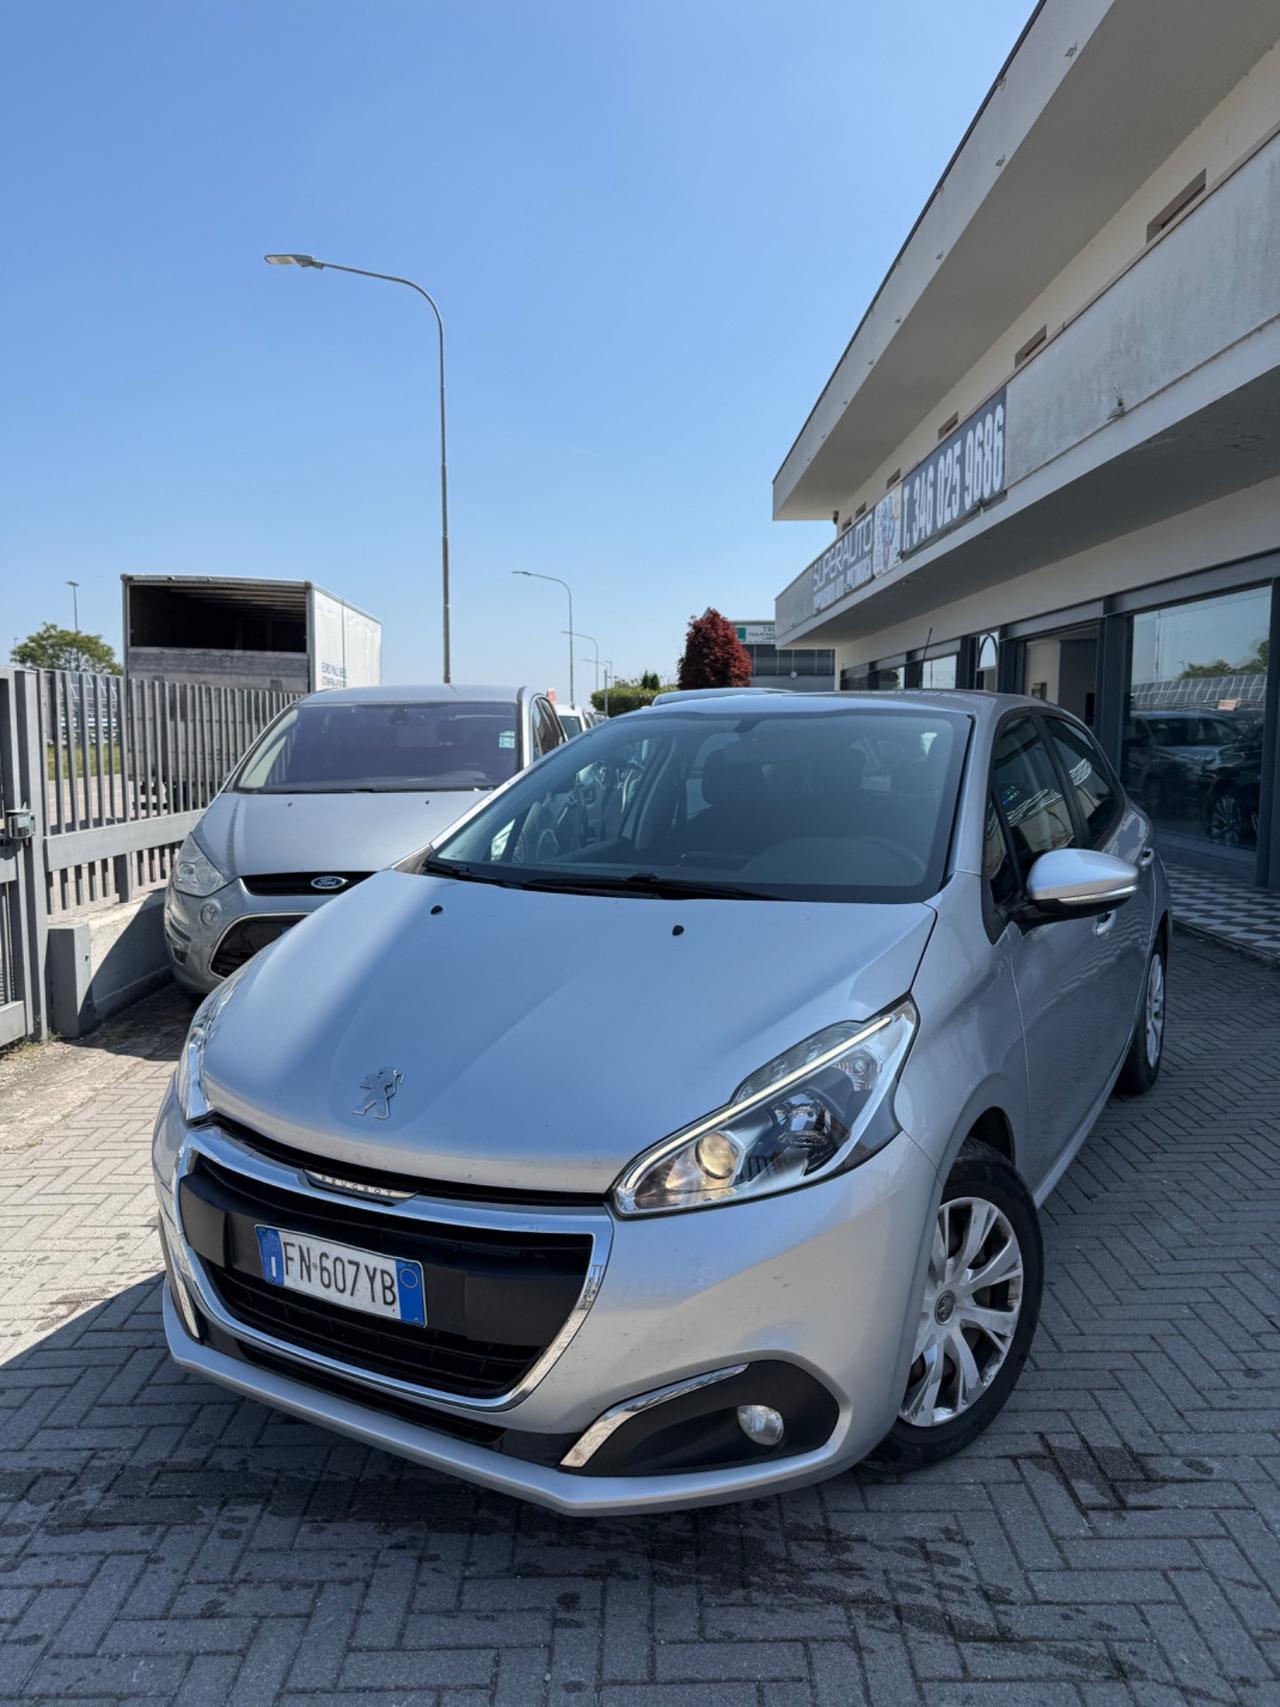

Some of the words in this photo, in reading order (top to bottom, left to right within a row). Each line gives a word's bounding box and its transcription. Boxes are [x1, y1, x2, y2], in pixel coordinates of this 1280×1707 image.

[913, 463, 935, 545] 346
[936, 439, 962, 529] 025
[964, 404, 1004, 511] 9686
[813, 513, 874, 592] SUPERAUTO
[322, 1175, 393, 1197] PEUGEOT
